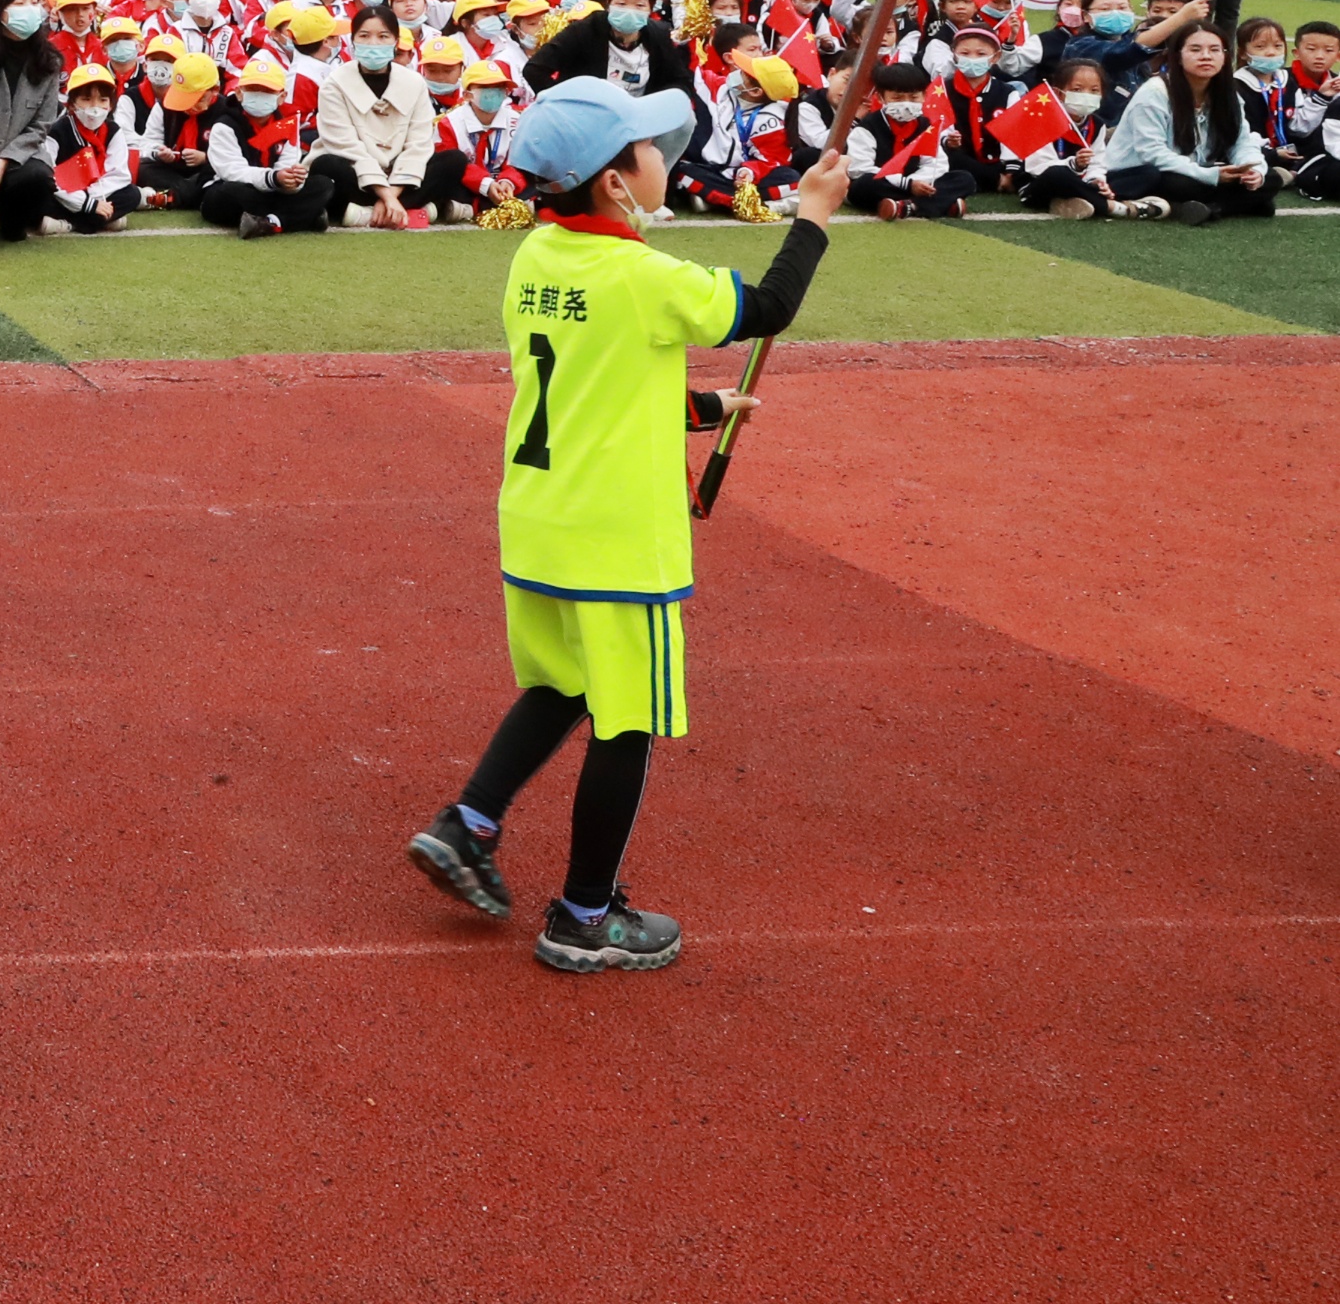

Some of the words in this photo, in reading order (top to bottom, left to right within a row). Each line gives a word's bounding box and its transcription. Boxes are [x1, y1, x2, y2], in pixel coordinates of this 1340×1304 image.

[518, 283, 587, 322] 洪麒尧
[512, 332, 556, 471] 1
